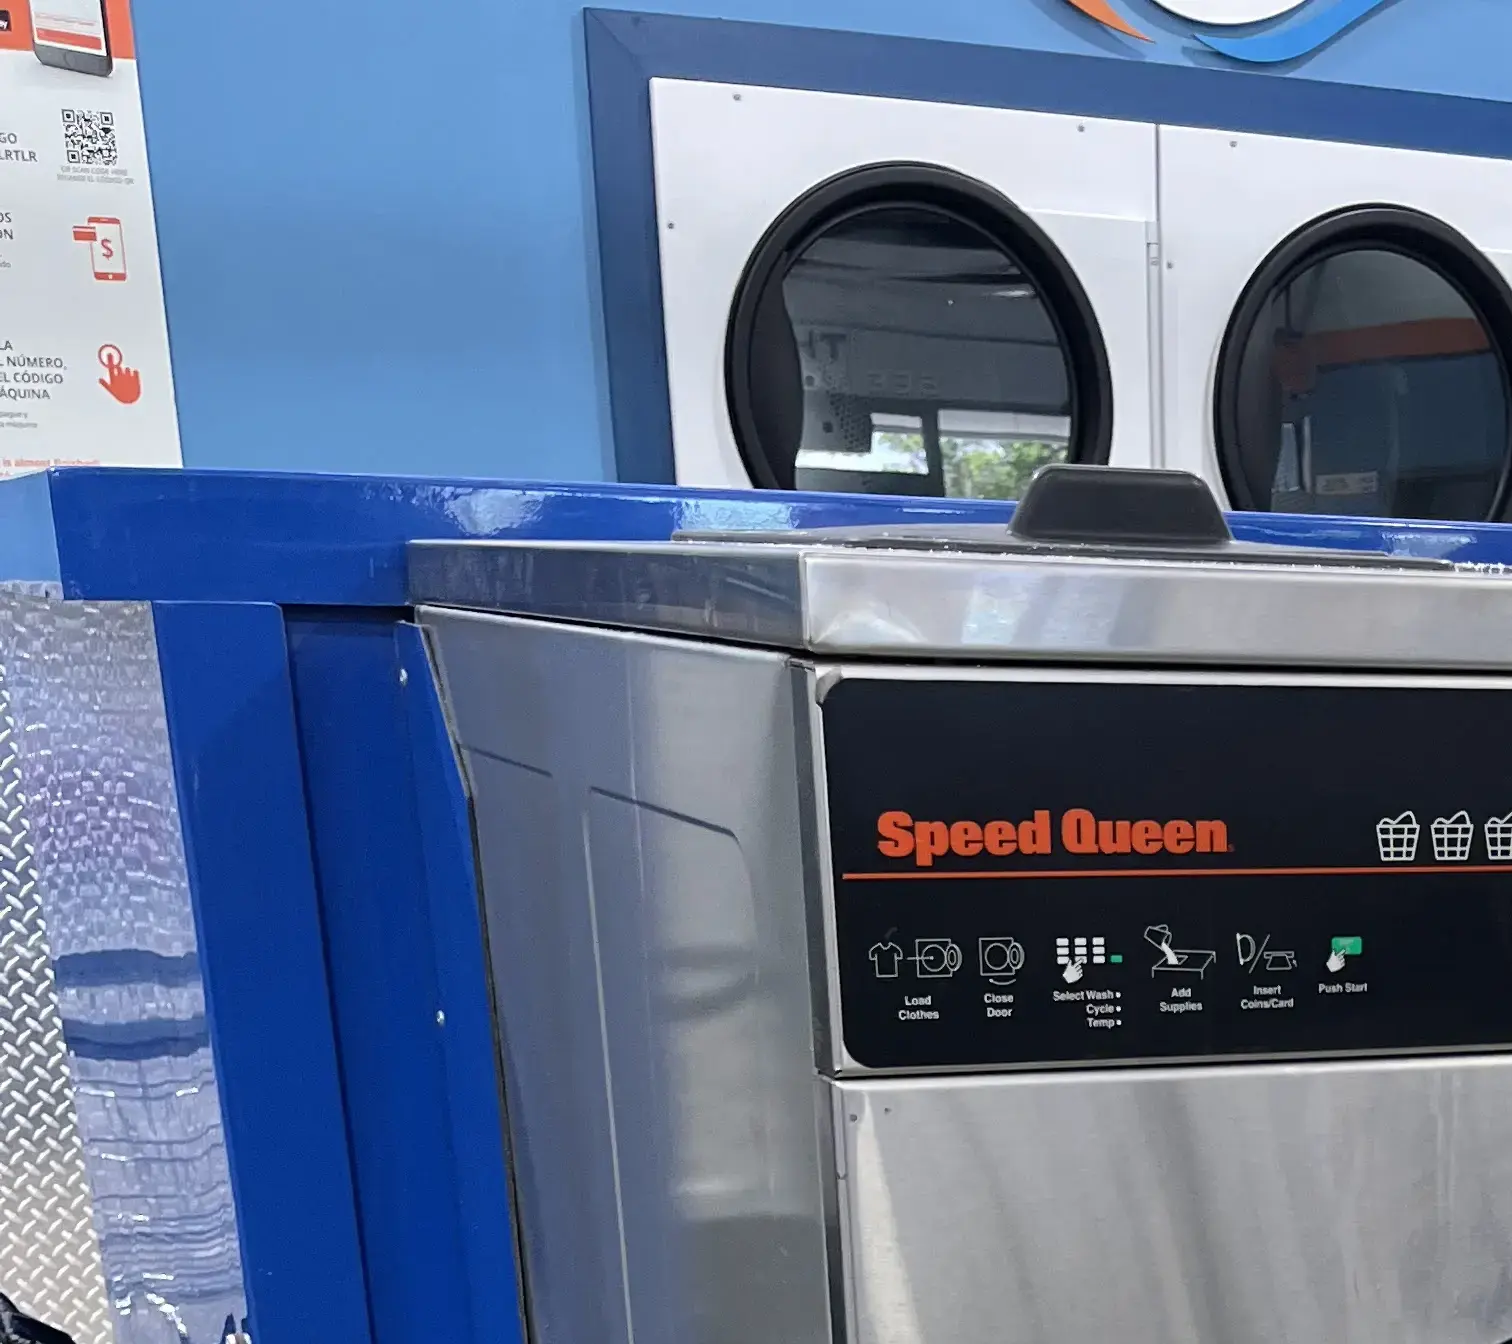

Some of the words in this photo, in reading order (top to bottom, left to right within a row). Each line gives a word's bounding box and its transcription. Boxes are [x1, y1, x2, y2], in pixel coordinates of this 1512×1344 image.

[0, 149, 38, 162] RTLR
[13, 370, 63, 384] CÓDIGO
[876, 808, 1052, 868] Speed
[1060, 808, 1229, 856] Queen
[1170, 987, 1192, 998] Add
[1253, 984, 1282, 995] Insert
[1318, 983, 1343, 994] Push
[1344, 982, 1368, 993] Start
[904, 995, 932, 1006] Load
[983, 993, 1014, 1004] Close
[1052, 991, 1084, 1002] Select
[1085, 990, 1114, 1001] Wash
[1085, 1004, 1115, 1016] Cycle
[1159, 1001, 1204, 1014] Supplies
[1240, 998, 1295, 1010] Coins/Card
[898, 1009, 940, 1021] Clothes
[986, 1007, 1013, 1018] Door
[1086, 1018, 1116, 1029] Temp
